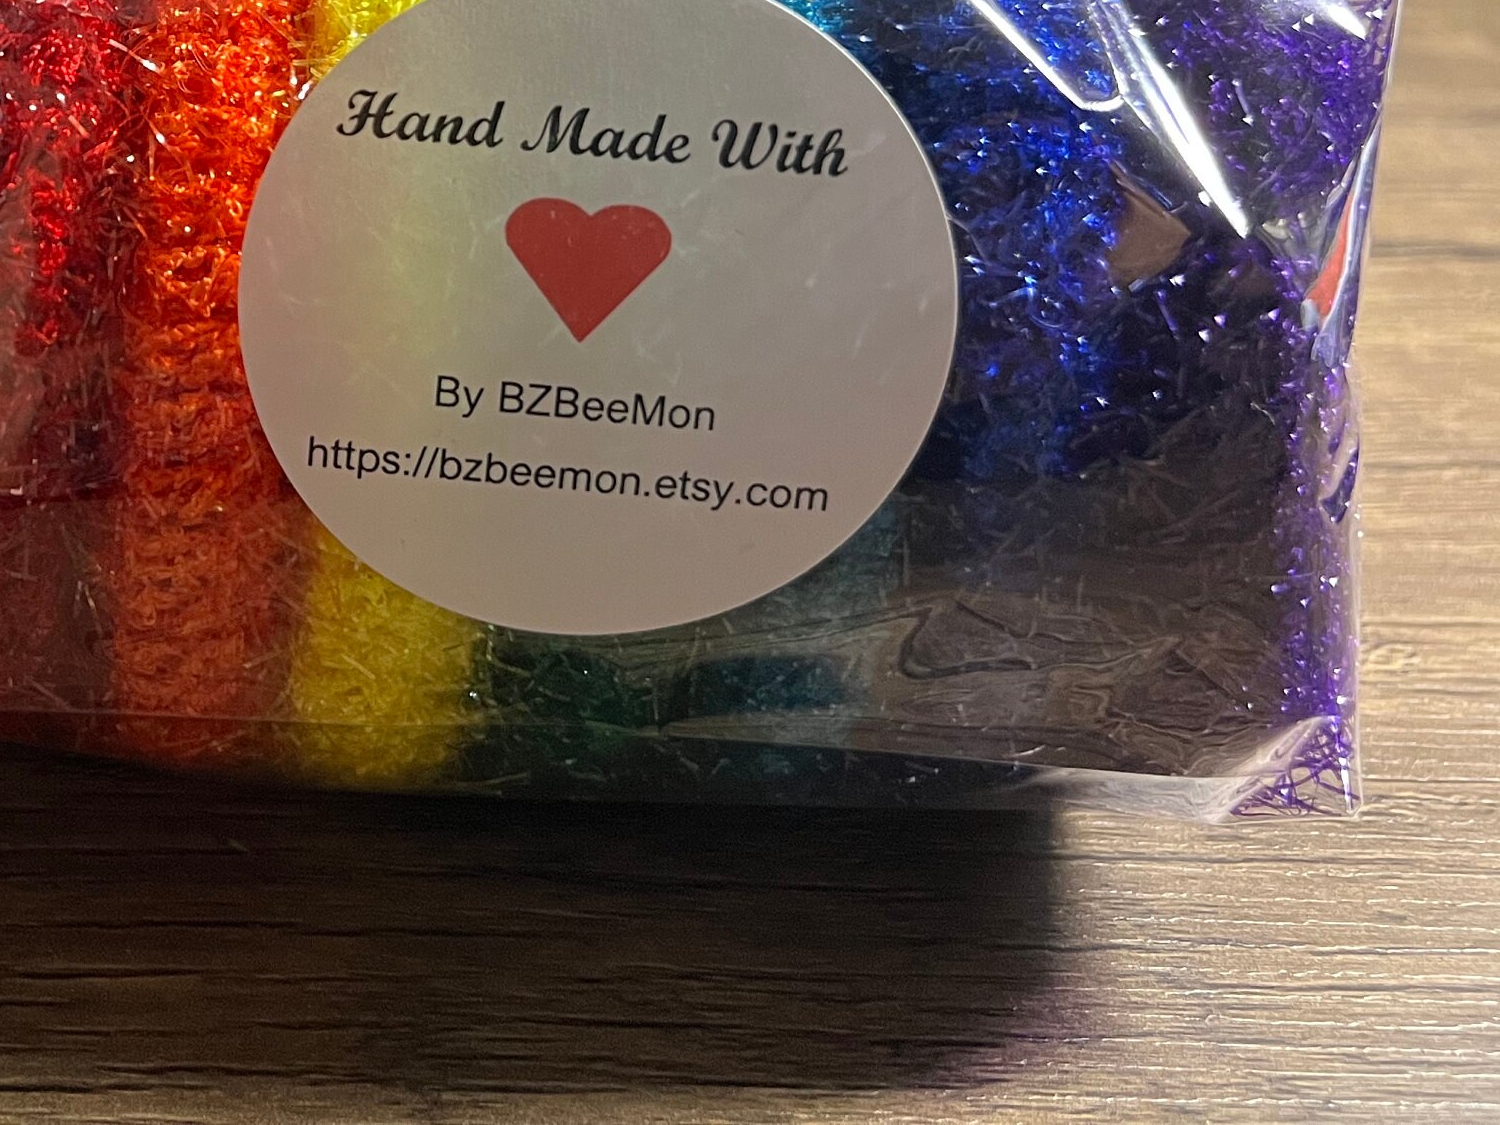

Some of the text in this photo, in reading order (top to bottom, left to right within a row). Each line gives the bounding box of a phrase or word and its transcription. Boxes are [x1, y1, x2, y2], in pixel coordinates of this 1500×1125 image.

[335, 88, 849, 178] Hand Made With
[434, 374, 715, 431] By BZBeeMon
[307, 435, 829, 513] https://bzbeemon.etsy.com
